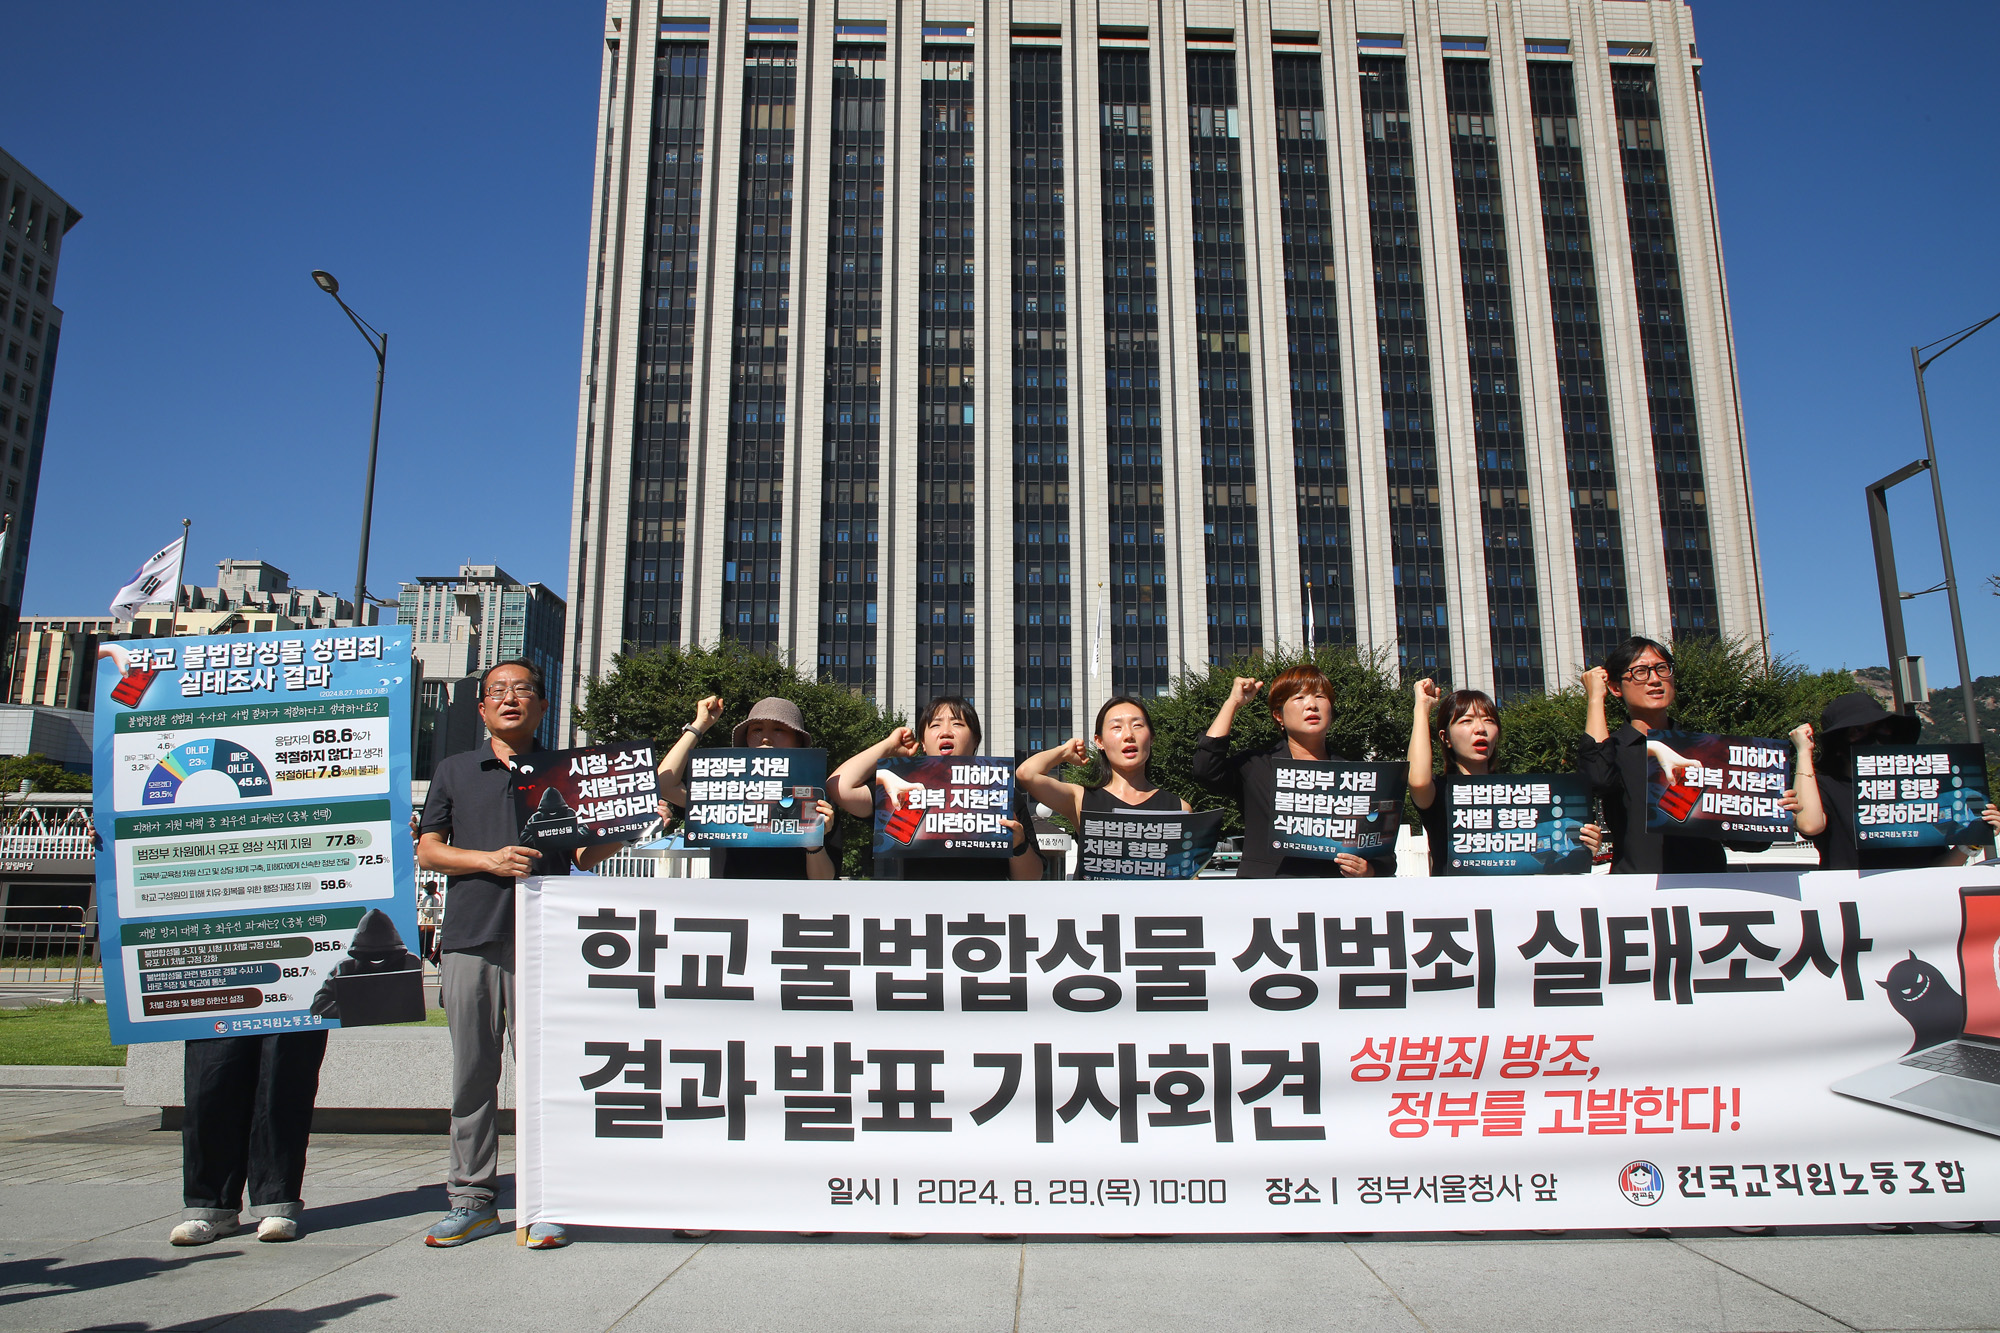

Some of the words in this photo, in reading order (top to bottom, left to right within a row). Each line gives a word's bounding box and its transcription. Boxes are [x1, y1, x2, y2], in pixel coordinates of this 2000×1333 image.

[128, 648, 177, 672] 학교
[182, 640, 305, 671] 불법합성물
[311, 635, 383, 662] 성범죄
[178, 666, 278, 697] 실태조사
[282, 664, 333, 691] 결과
[128, 714, 167, 728] 불법합성물
[171, 712, 194, 724] 성범죄
[196, 711, 228, 723] 수사와
[231, 708, 249, 721] 사법
[252, 707, 280, 720] 절차가
[283, 705, 326, 719] 적절하다고
[329, 702, 379, 715] 생각하나요?
[157, 742, 176, 750] 4.6%
[275, 734, 311, 747] 응답자의
[312, 728, 371, 744] 68.6%가
[185, 745, 209, 755] 아니다
[230, 751, 249, 762] 매우
[275, 748, 326, 764] 적절하지
[327, 747, 361, 761] 않다고
[363, 747, 383, 759] 생각!
[1728, 745, 1786, 769] 피해자
[131, 763, 150, 771] 3.2%
[188, 758, 207, 767] 23%
[227, 762, 255, 774] 아니다
[275, 768, 316, 781] 적절하다
[317, 765, 357, 778] 7.8%에
[358, 764, 379, 776] 불과!
[691, 757, 746, 777] 범정부
[751, 757, 789, 777] 차원
[1856, 754, 1951, 776] 불법합성물
[238, 776, 268, 787] 45.6%
[950, 765, 1010, 786] 피해자
[1276, 768, 1335, 791] 범정부
[1339, 771, 1377, 792] 차원
[1684, 766, 1724, 789] 회복
[1727, 770, 1785, 795] 지원책
[149, 790, 173, 799] 23.5%
[689, 780, 783, 800] 불법합성물
[908, 788, 945, 810] 회복
[949, 788, 1008, 810] 지원책
[1452, 783, 1551, 805] 불법합성물
[1857, 779, 1896, 800] 처벌
[1900, 778, 1939, 799] 형량
[576, 793, 659, 824] 신설하라!
[1274, 791, 1371, 816] 불법합성물
[133, 821, 161, 833] 피해자
[165, 818, 182, 832] 지원
[185, 816, 204, 830] 대책
[206, 817, 217, 828] 중
[219, 814, 246, 828] 최우선
[250, 812, 284, 825] 과제는?
[286, 810, 309, 822] (중복
[312, 808, 332, 821] 선택)
[688, 803, 769, 825] 삭제하라!
[1452, 808, 1492, 829] 처벌
[1497, 808, 1538, 829] 형량
[1857, 803, 1939, 825] 강화하라!
[537, 825, 573, 837] 불법합성물
[697, 831, 748, 841] 전국교직원노동조합
[770, 818, 805, 835] DEL
[1084, 819, 1182, 840] 불법합성물
[1273, 814, 1357, 839] 삭제하라!
[1732, 823, 1789, 833] 전국교직원노동조합
[1868, 830, 1919, 839] 전국교직원노동조합
[137, 847, 170, 861] 범정부
[172, 844, 216, 858] 차원에서
[217, 842, 240, 855] 유포
[242, 840, 264, 853] 영상
[266, 838, 288, 851] 삭제
[290, 837, 312, 850] 지원
[325, 833, 364, 847] 77.8%
[955, 840, 1009, 849] 전국교직원노동조합
[1083, 838, 1122, 857] 처벌
[1128, 841, 1168, 859] 형량
[1283, 841, 1336, 853] 전국교직원노동조합
[1357, 832, 1383, 849] DEL
[1453, 833, 1537, 853] 강화하라!
[182, 868, 197, 878] 차원
[197, 867, 212, 877] 신고
[220, 865, 234, 875] 상담
[266, 860, 300, 871] 피해자에게
[322, 858, 336, 867] 정보
[358, 854, 390, 866] 72.5%
[1083, 857, 1166, 877] 강화하라!
[1463, 859, 1516, 867] 전국교직원노동조합
[141, 893, 157, 902] 학교
[158, 890, 188, 901] 구성원의
[189, 889, 205, 899] 피해
[246, 884, 262, 894] 위한
[296, 881, 312, 891] 지원
[320, 879, 353, 890] 59.6%
[139, 926, 157, 939] 재발
[160, 926, 178, 938] 방지
[180, 924, 199, 937] 대책
[202, 923, 212, 935] 중
[215, 920, 242, 934] 최우선
[245, 919, 279, 931] 과제는?
[281, 917, 304, 929] (중복
[307, 914, 328, 927] 선택)
[182, 946, 197, 956] 소지
[232, 942, 248, 952] 처벌
[249, 941, 264, 950] 규정
[314, 940, 347, 952] 85.6%
[577, 908, 755, 1009] 학교
[771, 913, 1216, 1013] 불법합성물
[1233, 909, 1497, 1011] 성범죄
[1517, 901, 1873, 1006] 실태조사
[144, 959, 160, 968] 유포
[170, 957, 186, 966] 처벌
[187, 956, 202, 965] 규정
[203, 954, 219, 964] 강화
[183, 969, 199, 979] 관련
[199, 968, 221, 978] 범죄로
[239, 966, 254, 975] 수사
[282, 966, 316, 978] 68.7%
[163, 981, 178, 990] 직장
[149, 1000, 164, 1010] 처벌
[165, 999, 180, 1009] 강화
[190, 997, 205, 1008] 형량
[206, 995, 228, 1006] 하한선
[229, 994, 244, 1004] 설정
[264, 993, 293, 1003] 58.6%
[232, 1014, 322, 1032] 전국교직원노동조합
[1348, 1036, 1490, 1083] 성범죄
[1499, 1033, 1602, 1082] 방조,
[579, 1039, 757, 1141] 결과
[774, 1042, 953, 1142] 발표
[969, 1042, 1327, 1144] 기자회견
[1386, 1090, 1527, 1139] 정부를
[1537, 1085, 1742, 1136] 고발한다!
[1149, 1179, 1227, 1204] 10:00
[1357, 1173, 1523, 1204] 정부서울청사
[1530, 1173, 1558, 1202] 앞
[1677, 1160, 1966, 1198] 전국교직원노동조합
[1632, 1191, 1656, 1202] 참교육
